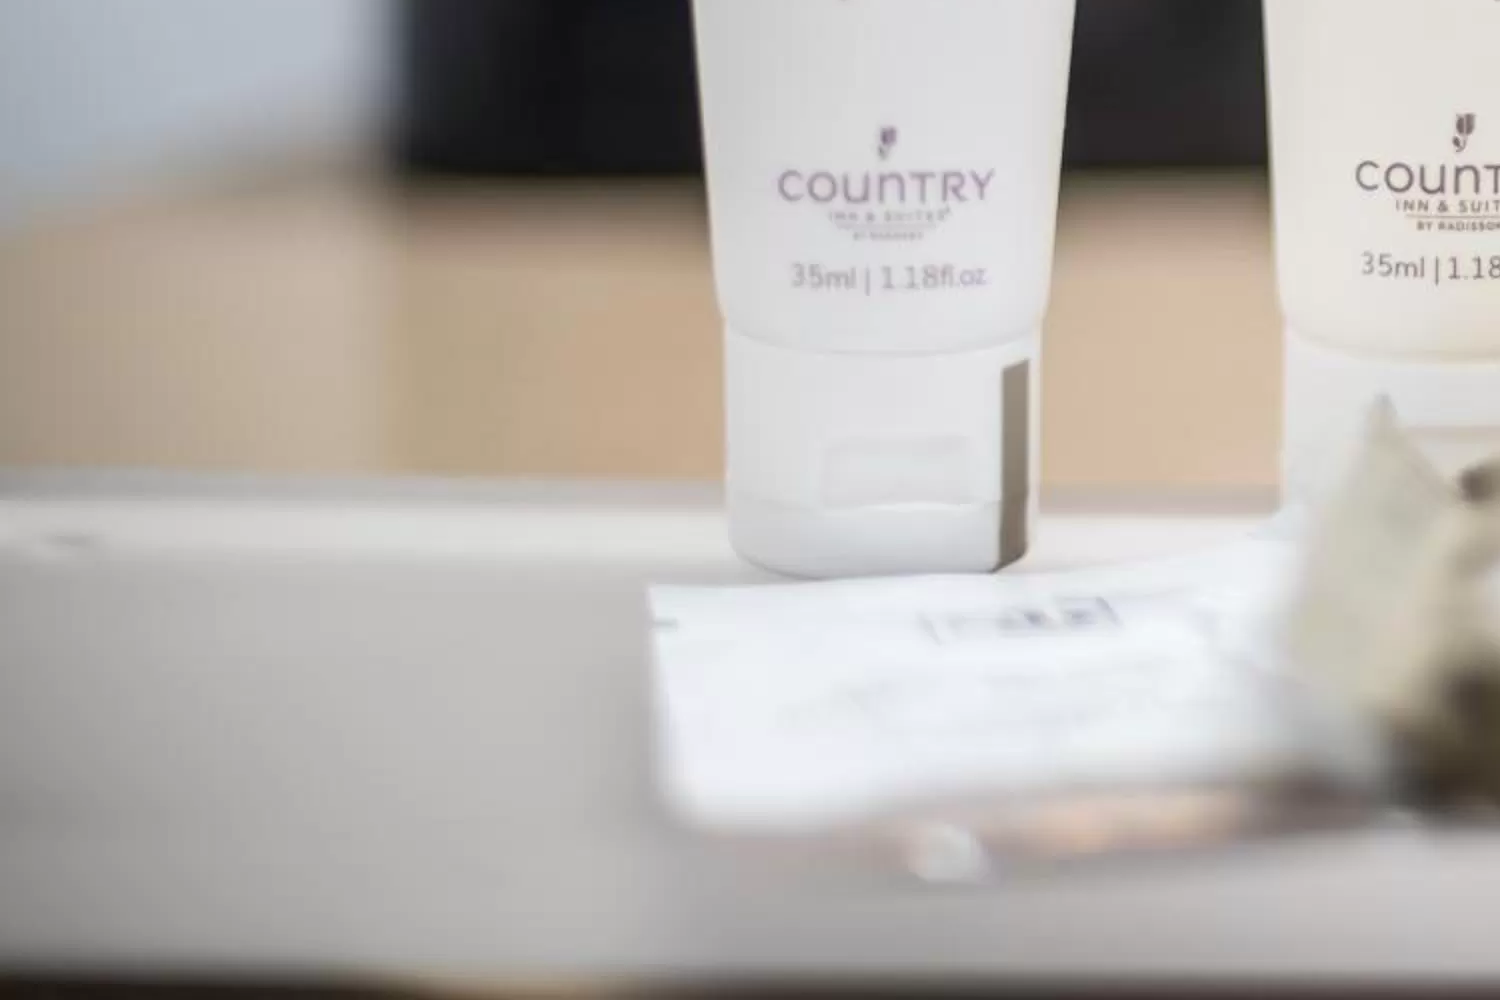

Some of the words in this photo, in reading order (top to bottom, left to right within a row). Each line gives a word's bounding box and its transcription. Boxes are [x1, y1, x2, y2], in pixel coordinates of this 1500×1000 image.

[1396, 199, 1429, 212] INN
[1437, 199, 1449, 213] &
[1416, 220, 1432, 231] BY
[1361, 251, 1425, 277] 35ml
[791, 262, 856, 289] 35ml
